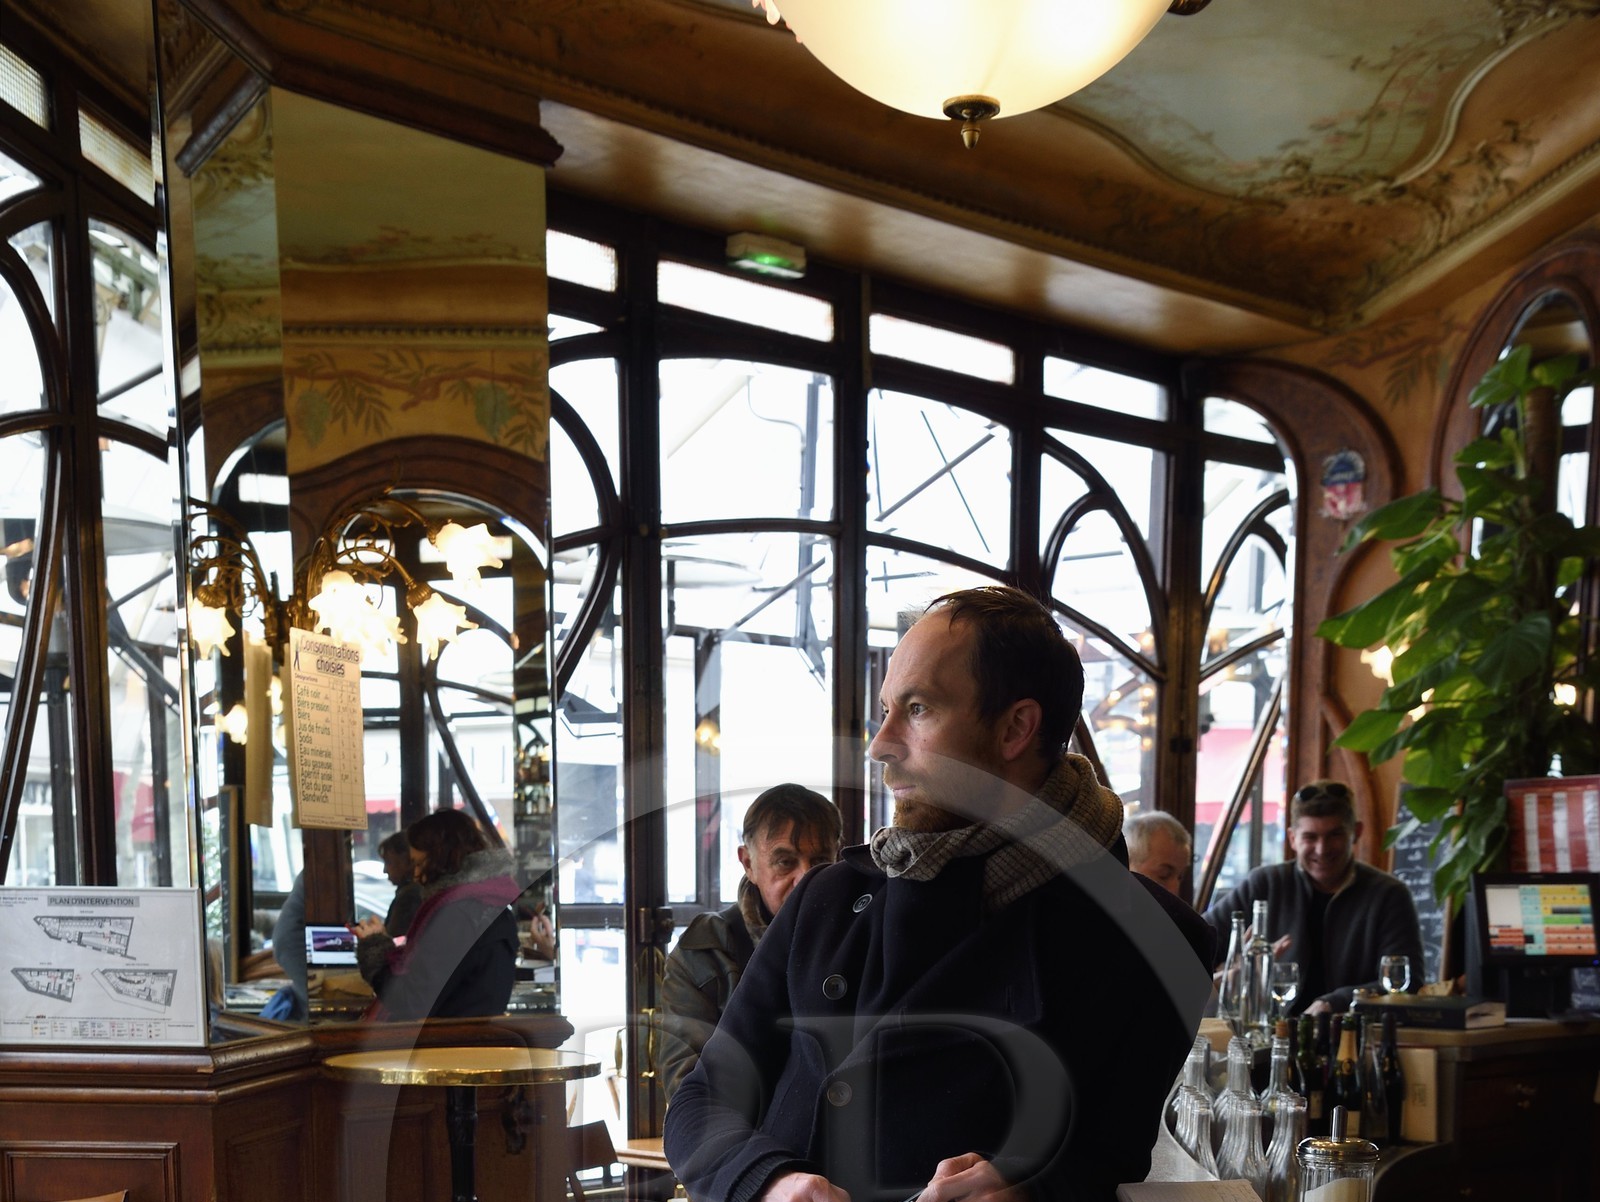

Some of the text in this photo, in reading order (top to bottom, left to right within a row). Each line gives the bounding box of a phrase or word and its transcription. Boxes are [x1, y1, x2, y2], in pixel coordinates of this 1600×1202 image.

[300, 636, 360, 663] Consommations
[316, 657, 346, 677] choisies
[297, 684, 310, 697] Café
[308, 722, 314, 733] de
[315, 723, 331, 736] fruits
[298, 732, 312, 744] Soda
[300, 743, 310, 755] Eau
[300, 755, 311, 767] Eau
[301, 779, 332, 794] Plat du jour
[302, 791, 329, 804] Sandwich
[50, 897, 134, 906] PLAN D'INTERVENTION
